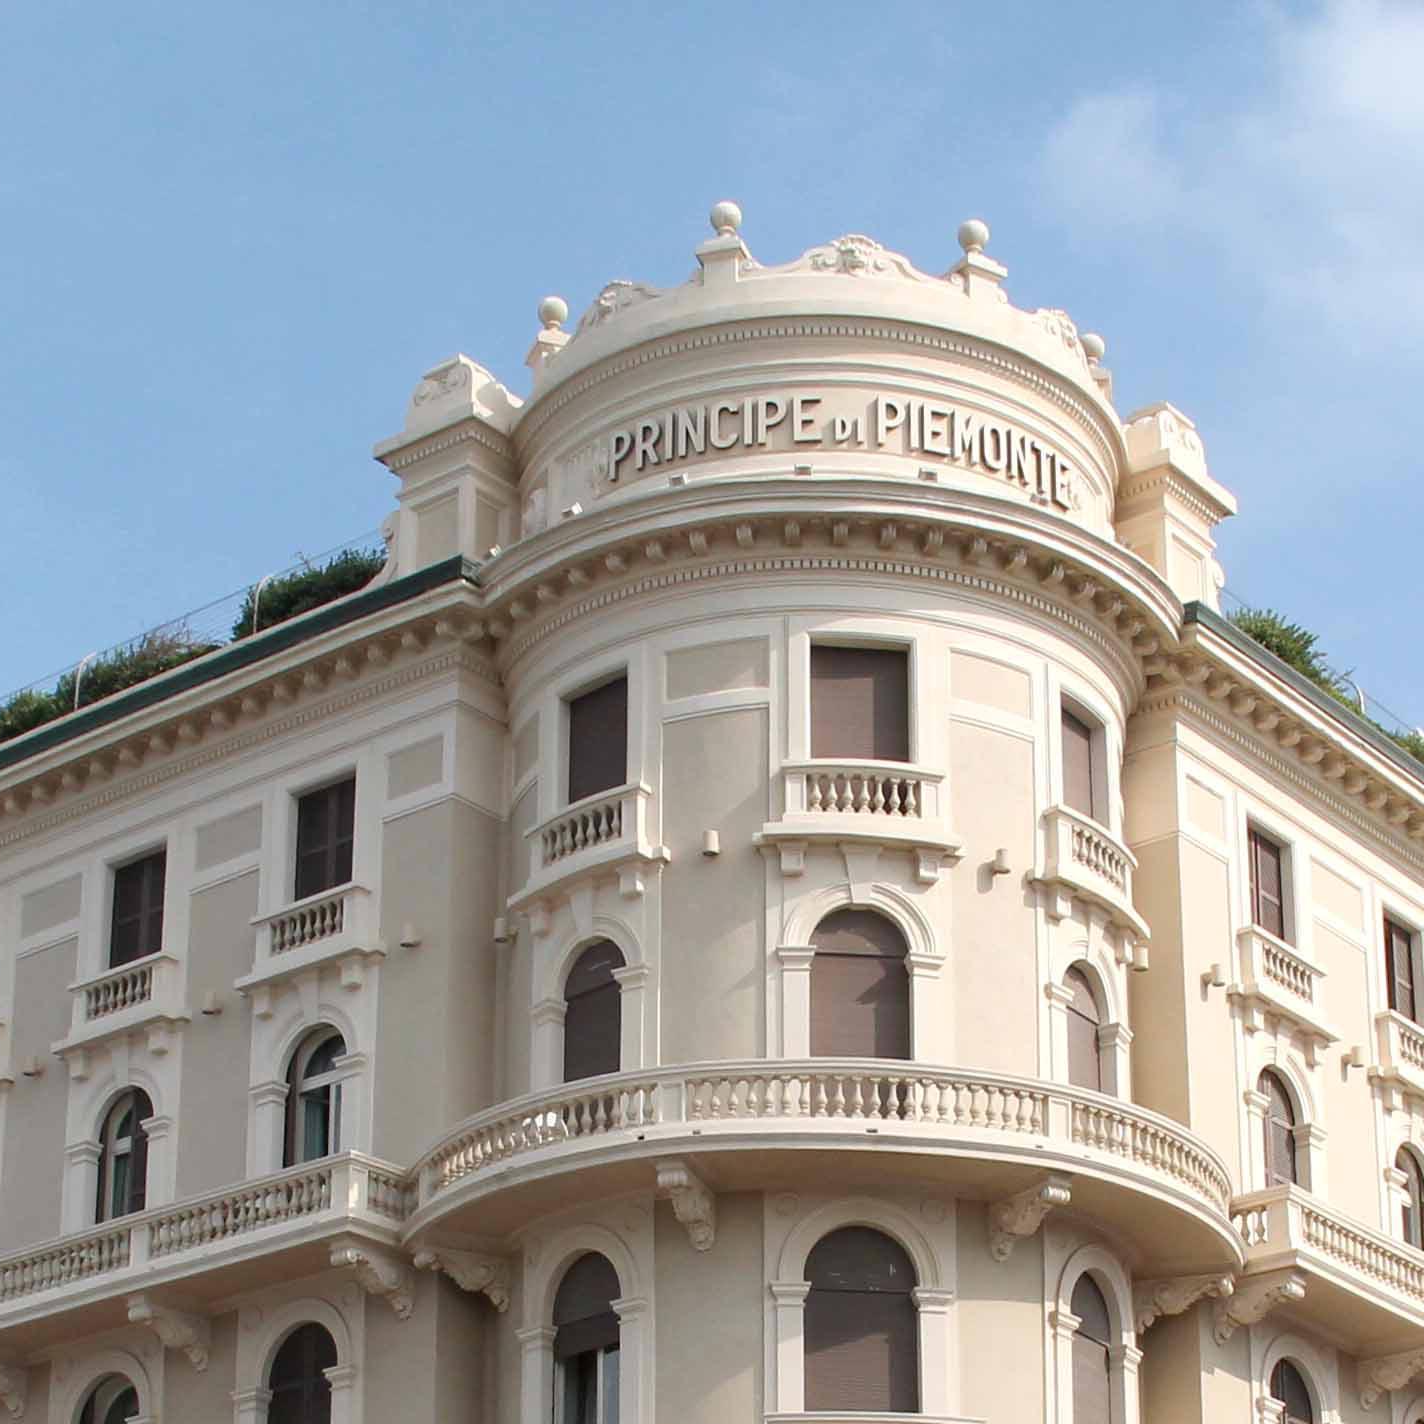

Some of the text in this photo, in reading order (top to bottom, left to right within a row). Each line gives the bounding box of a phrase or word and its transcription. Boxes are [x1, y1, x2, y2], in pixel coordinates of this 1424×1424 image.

[607, 394, 1073, 513] PRINCIPE DI PIEMONTE
